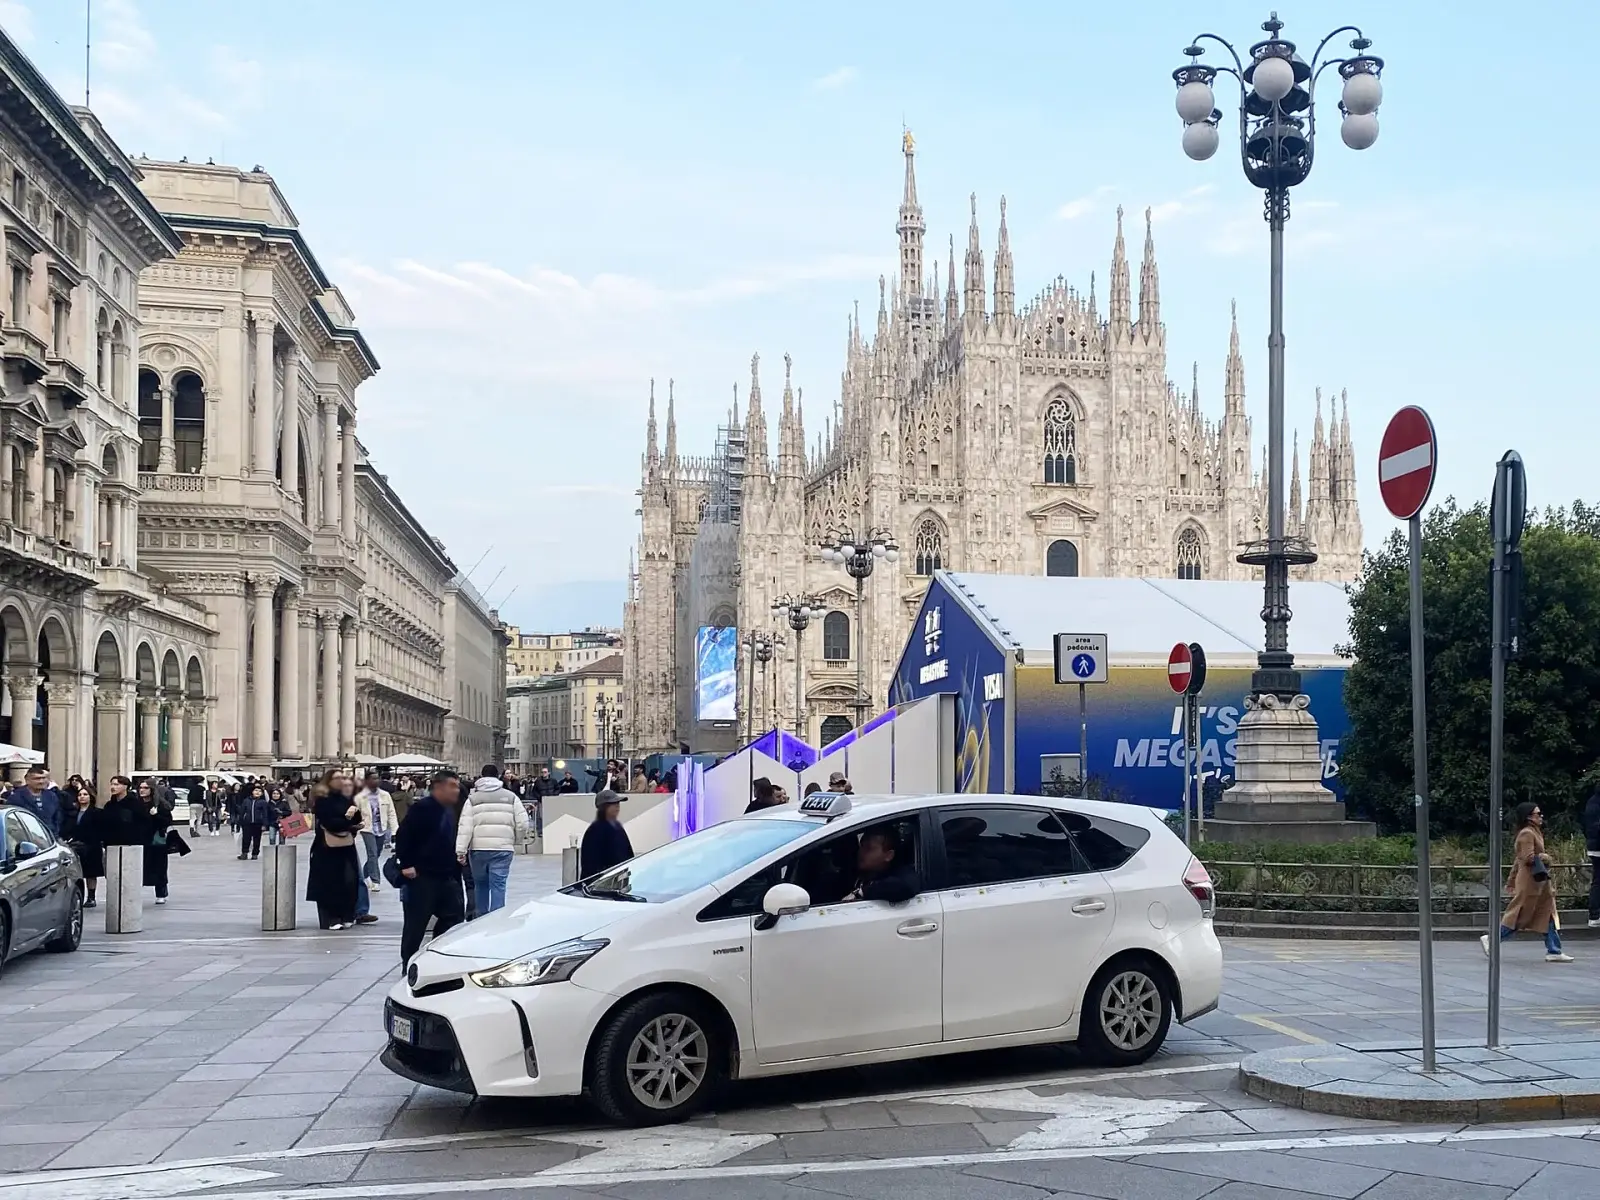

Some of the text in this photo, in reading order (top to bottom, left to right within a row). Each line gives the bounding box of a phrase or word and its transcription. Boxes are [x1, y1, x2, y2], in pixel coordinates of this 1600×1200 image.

[983, 673, 1003, 700] VISA
[1171, 706, 1239, 735] I'S
[223, 742, 235, 750] M
[804, 796, 834, 808] TAXI
